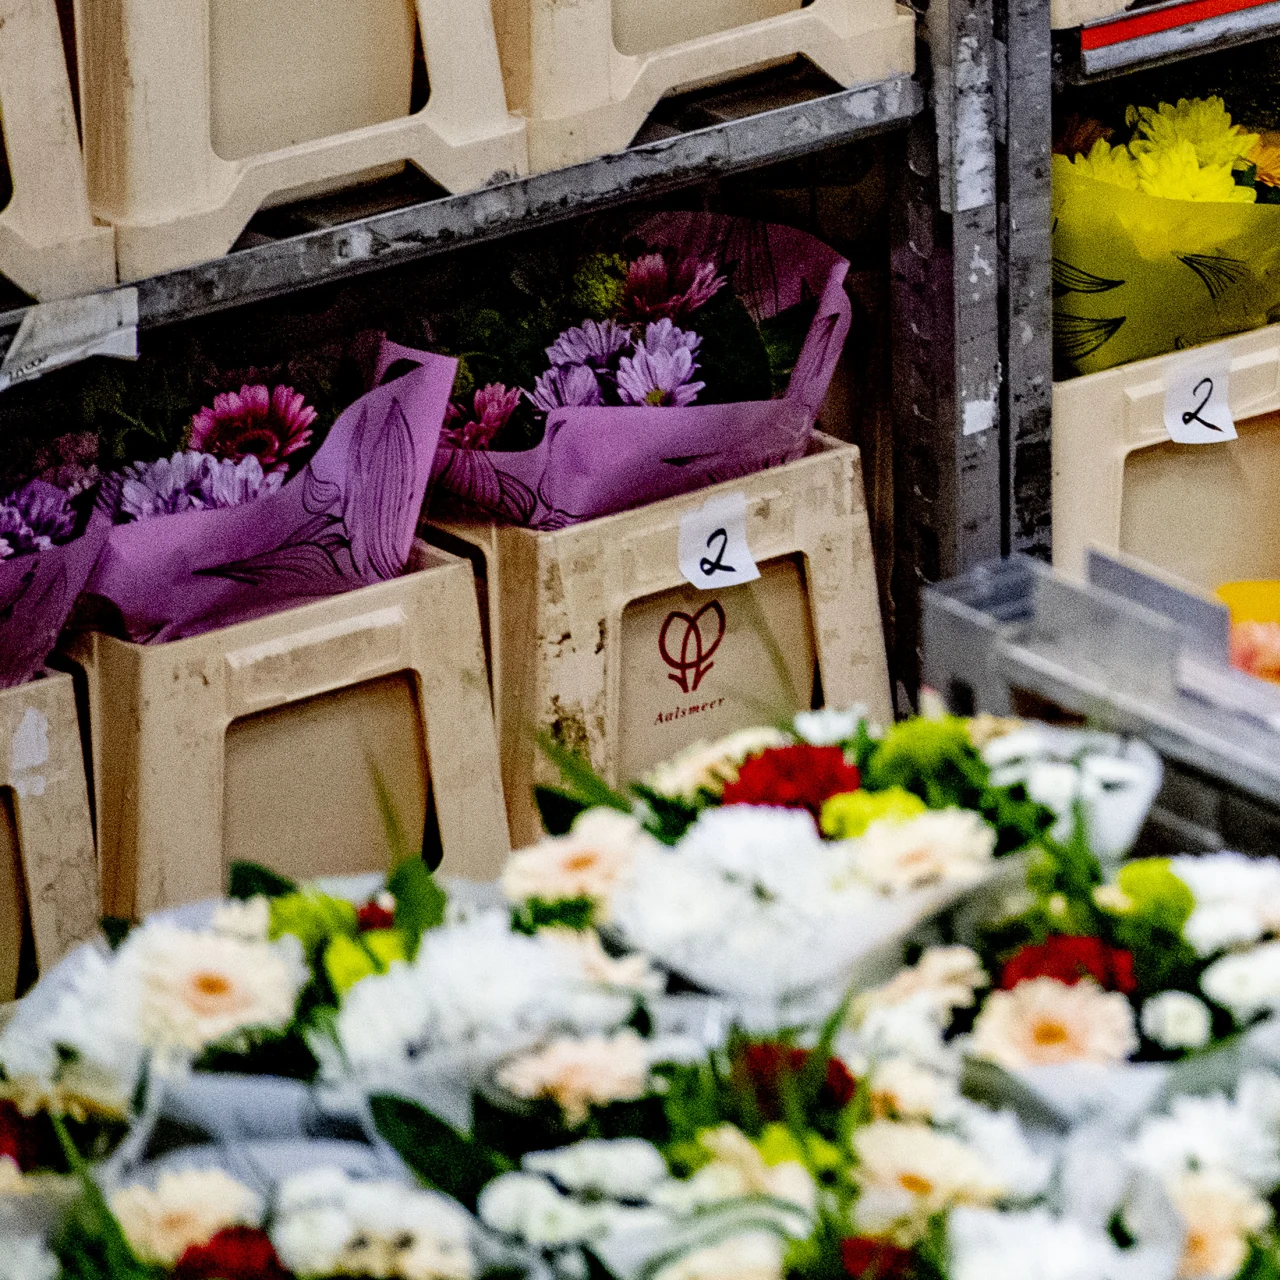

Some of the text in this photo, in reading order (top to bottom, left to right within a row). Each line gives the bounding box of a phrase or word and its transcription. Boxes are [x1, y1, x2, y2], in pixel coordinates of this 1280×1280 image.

[1181, 377, 1225, 433] 2
[699, 527, 737, 577] 2
[653, 697, 726, 726] Aalsmeer
